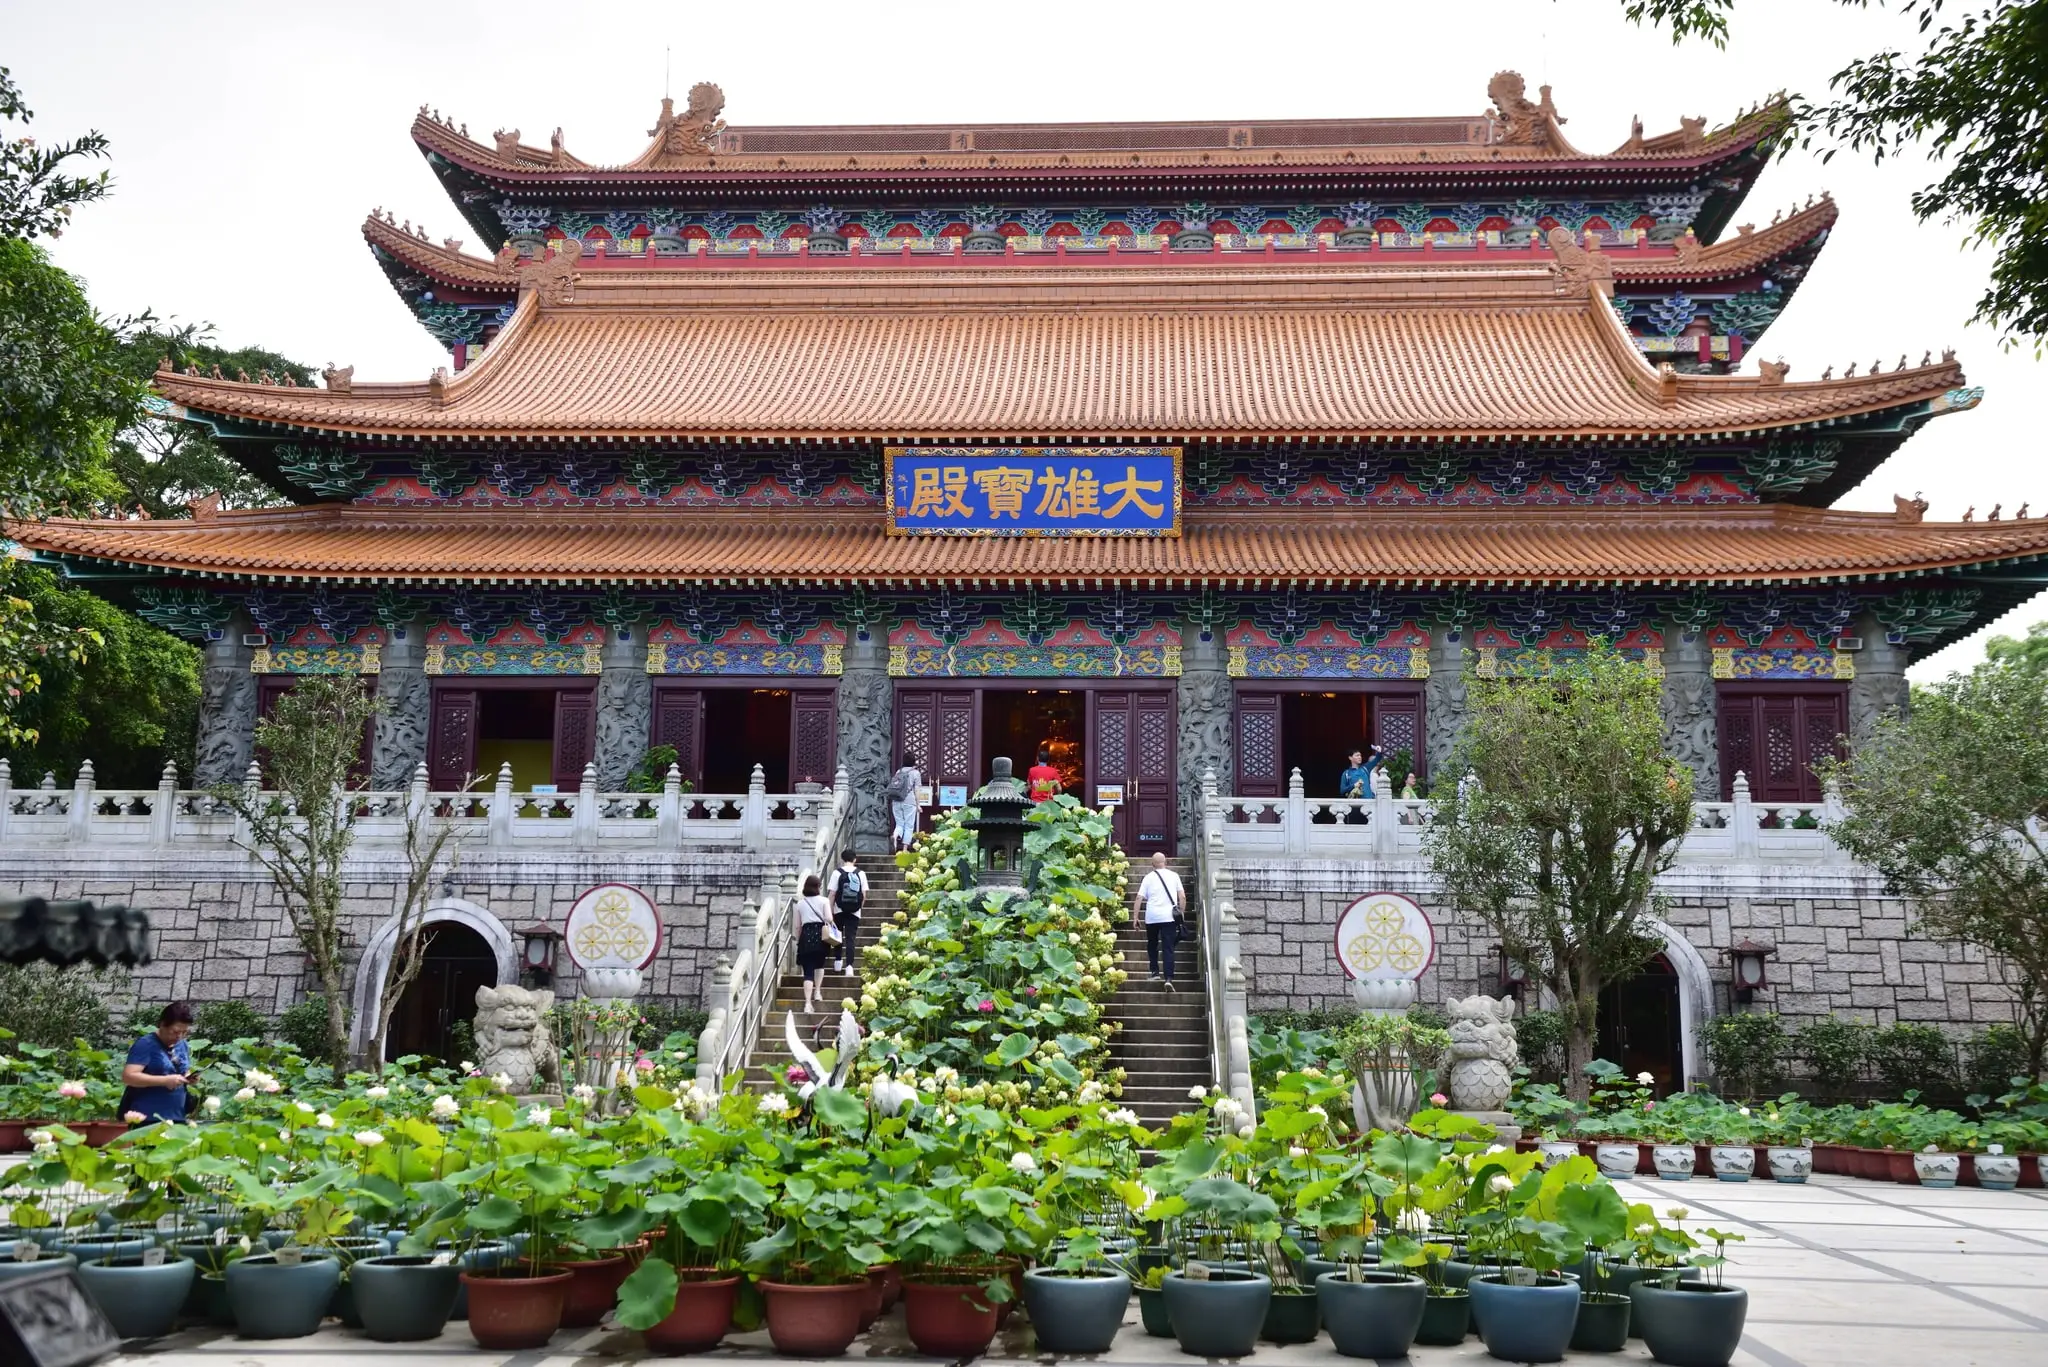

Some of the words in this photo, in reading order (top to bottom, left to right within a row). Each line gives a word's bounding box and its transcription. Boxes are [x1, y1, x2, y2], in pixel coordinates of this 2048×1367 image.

[955, 131, 970, 150] 有
[908, 465, 1164, 519] 大雄寶殿
